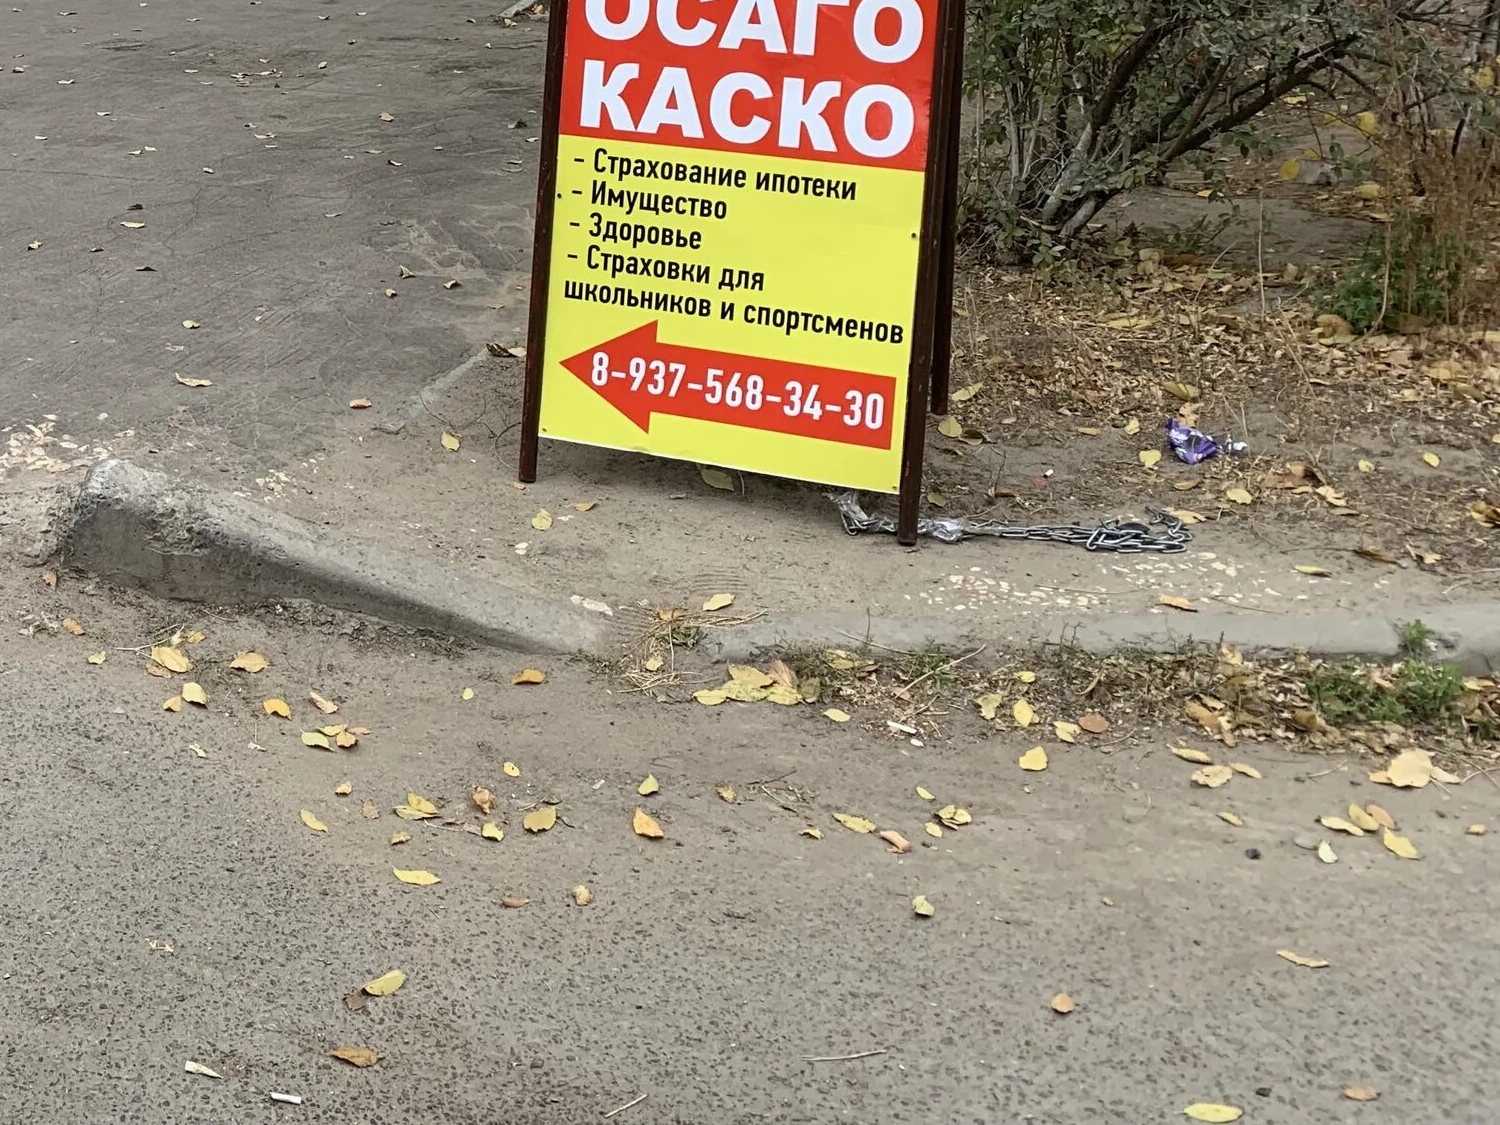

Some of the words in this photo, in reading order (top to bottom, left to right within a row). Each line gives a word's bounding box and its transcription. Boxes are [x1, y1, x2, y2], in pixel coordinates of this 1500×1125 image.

[579, 59, 915, 158] КАСКО
[590, 180, 728, 220] Имущество
[593, 147, 747, 189] Страхование
[755, 170, 857, 201] ипотеки
[588, 212, 702, 250] Здоровье
[586, 245, 711, 285] Страховки
[718, 267, 765, 291] для
[563, 280, 712, 318] школьников
[720, 301, 736, 321] и
[743, 303, 904, 344] спортсменов
[591, 351, 885, 430] 8-937-568-34-30
